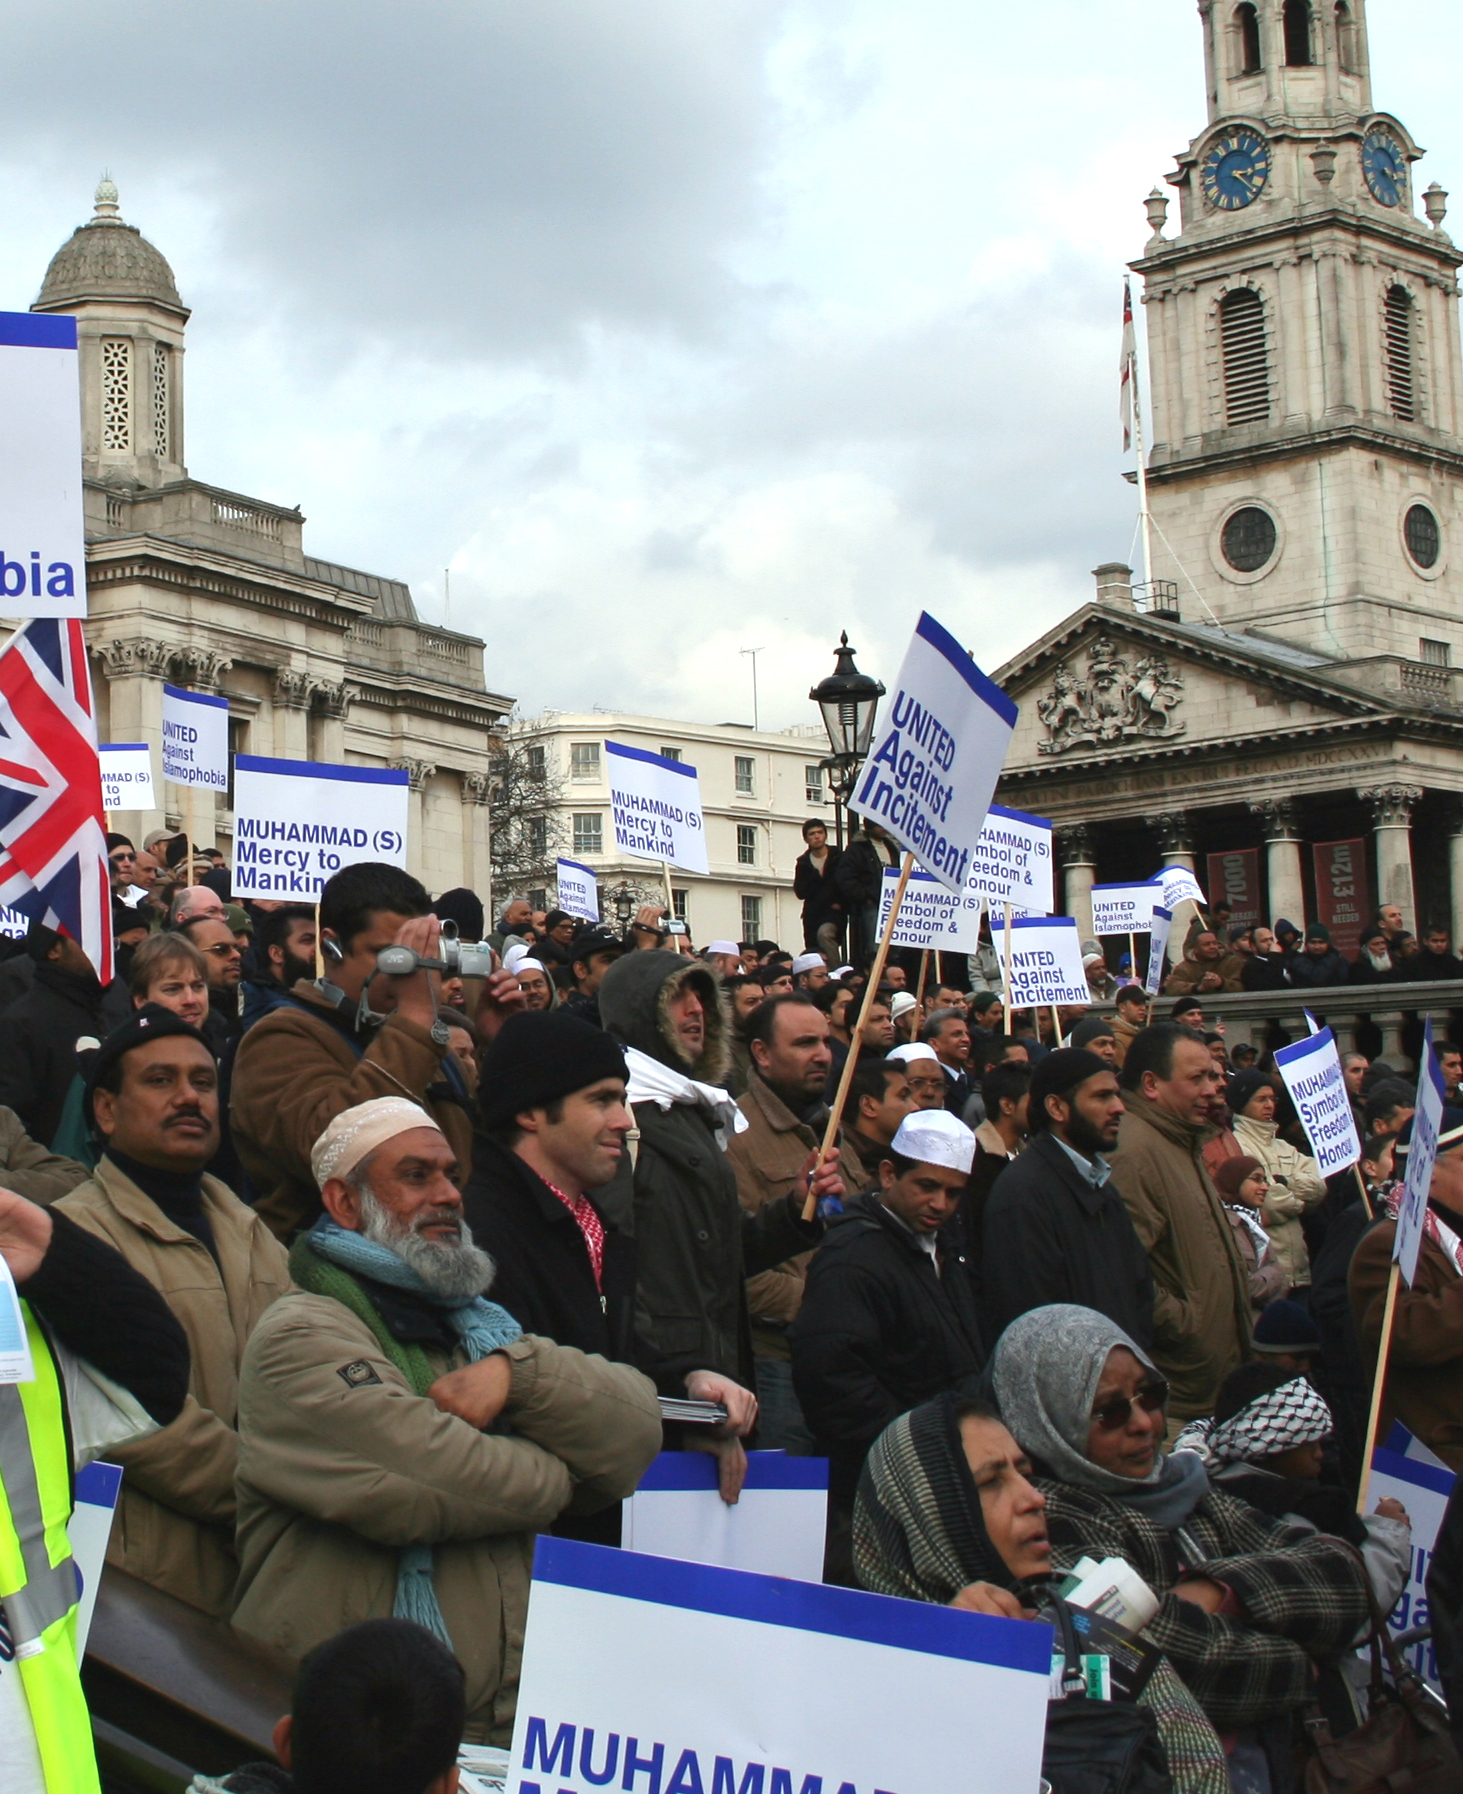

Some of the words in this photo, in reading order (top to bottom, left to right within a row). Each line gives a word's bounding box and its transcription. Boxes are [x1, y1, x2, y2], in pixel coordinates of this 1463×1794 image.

[162, 720, 198, 743] UNITED
[891, 690, 956, 772] UNITED
[162, 740, 194, 762] Against
[135, 772, 150, 784] (S)
[163, 757, 226, 786] Islamophobia
[872, 729, 953, 823] Against
[106, 785, 119, 794] to
[611, 789, 683, 822] MUHAMMAD
[685, 811, 702, 830] (S)
[614, 807, 656, 836] Mercy
[660, 819, 673, 838] to
[858, 765, 968, 885] Incitement
[238, 818, 368, 848] MUHAMMAD
[373, 830, 403, 854] (S)
[616, 827, 675, 858] Mankind
[237, 840, 310, 872] Mercy
[318, 848, 341, 870] to
[1015, 853, 1028, 867] of
[1034, 842, 1050, 858] (S)
[1023, 870, 1033, 886] &
[1222, 853, 1248, 906] 7000
[1330, 844, 1355, 898] £12m
[964, 877, 1011, 896] onour
[882, 899, 936, 917] Smbol
[940, 907, 954, 919] of
[884, 888, 961, 907] MHAMMAD
[963, 897, 980, 911] (S)
[1094, 901, 1135, 912] UNITED
[880, 914, 943, 931] Feedom
[948, 922, 958, 934] &
[1094, 912, 1133, 924] Against
[386, 954, 403, 963] JVC
